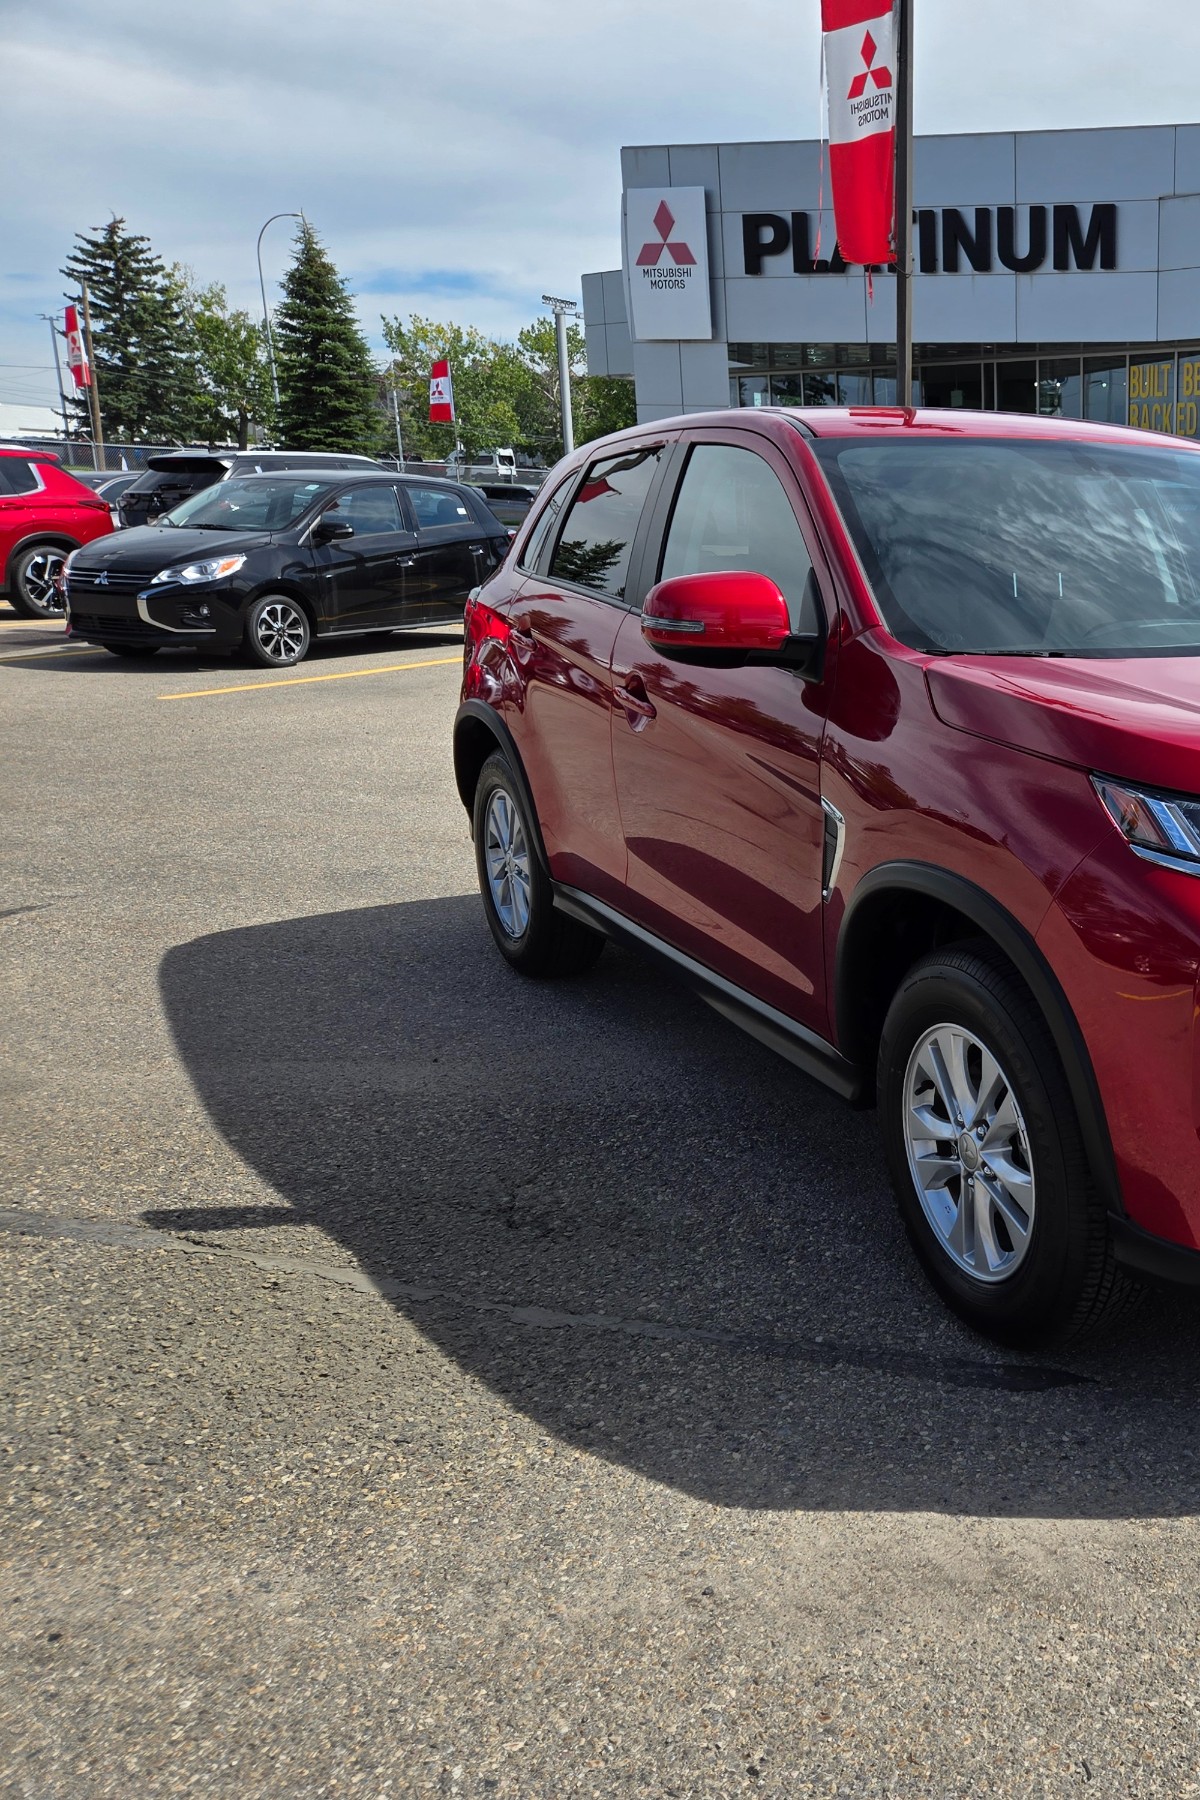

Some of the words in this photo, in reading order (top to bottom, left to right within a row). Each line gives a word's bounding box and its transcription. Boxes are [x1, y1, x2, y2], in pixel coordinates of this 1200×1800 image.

[742, 203, 1117, 275] PLINUM
[642, 267, 692, 279] MITSUBISHI
[650, 279, 686, 290] MOTORS
[1129, 363, 1172, 398] BUILT
